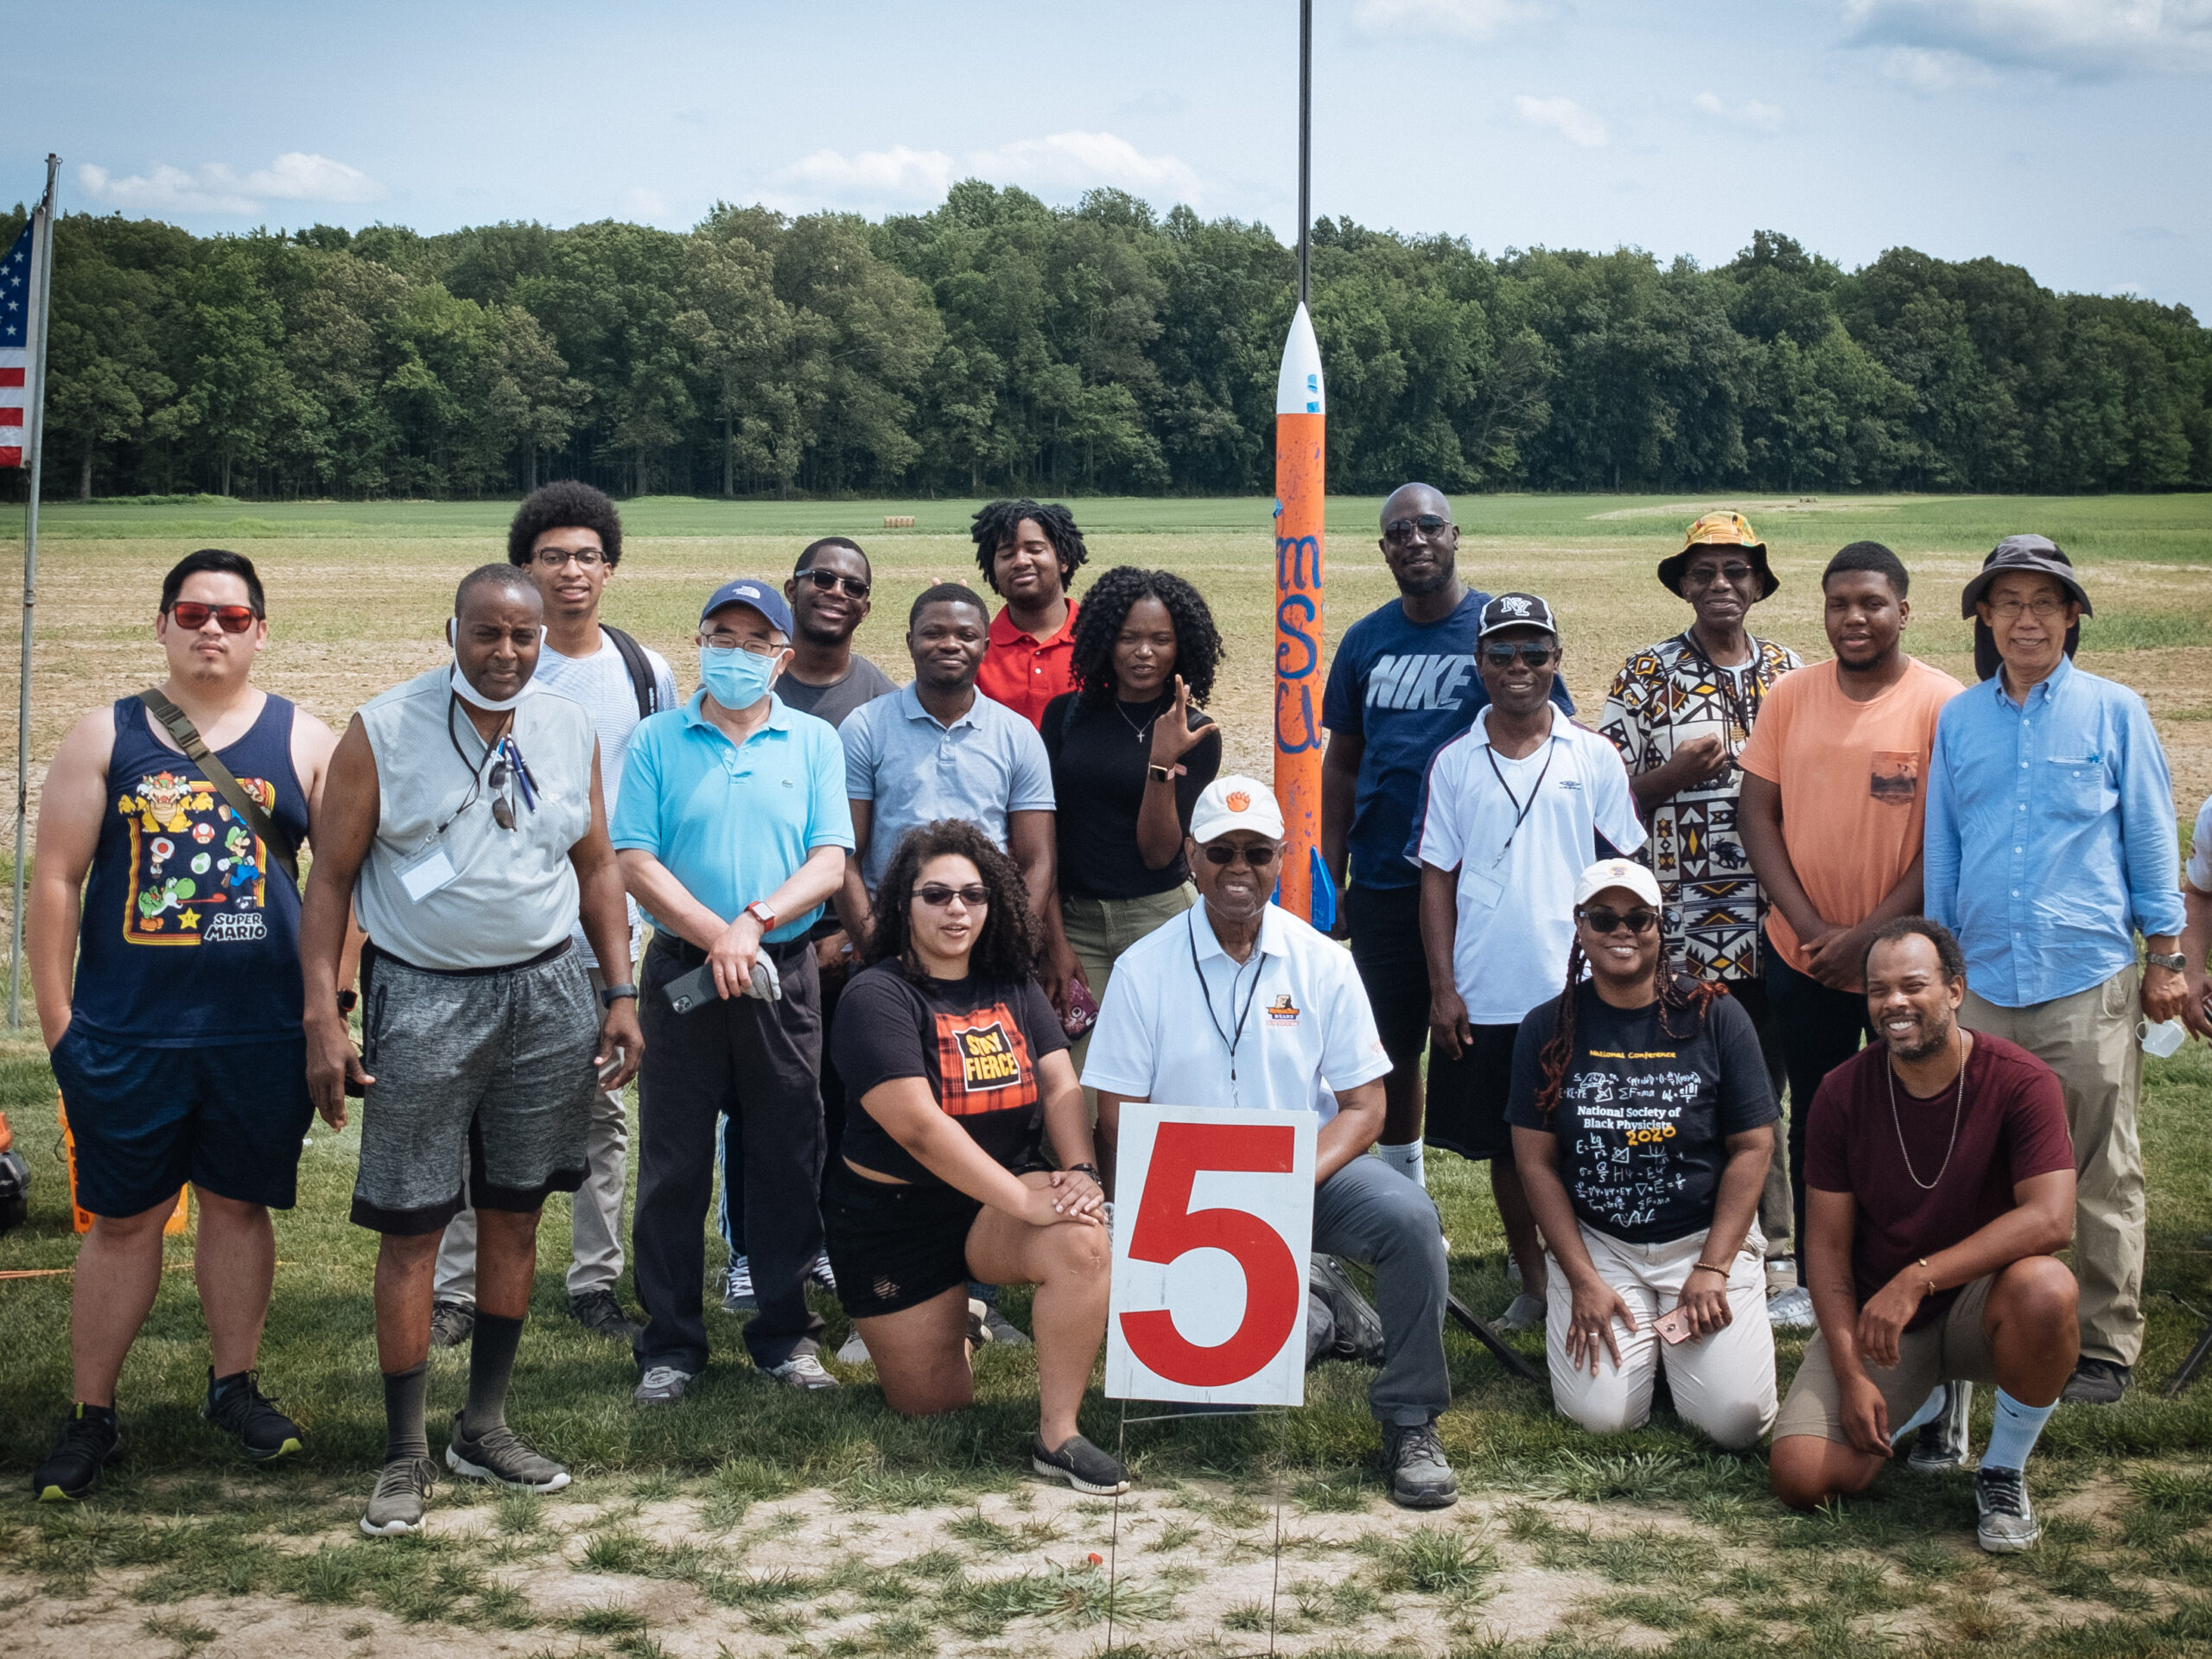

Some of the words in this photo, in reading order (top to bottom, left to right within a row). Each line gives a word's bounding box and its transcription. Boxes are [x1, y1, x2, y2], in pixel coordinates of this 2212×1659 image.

[1501, 597, 1532, 616] NY
[1365, 654, 1477, 710] NIKE
[214, 912, 263, 925] SUPER
[204, 924, 267, 941] MARIO
[965, 1032, 1002, 1056] STAY
[1590, 1050, 1625, 1058] National
[1628, 1052, 1676, 1060] Conference
[965, 1052, 1018, 1081] FIERCE
[1577, 1106, 1624, 1117] National
[1626, 1107, 1667, 1120] Society
[1668, 1107, 1681, 1117] of
[1583, 1118, 1614, 1128] Black
[1616, 1120, 1672, 1132] Physicists
[1626, 1126, 1676, 1145] 2020
[1120, 1122, 1300, 1388] 5
